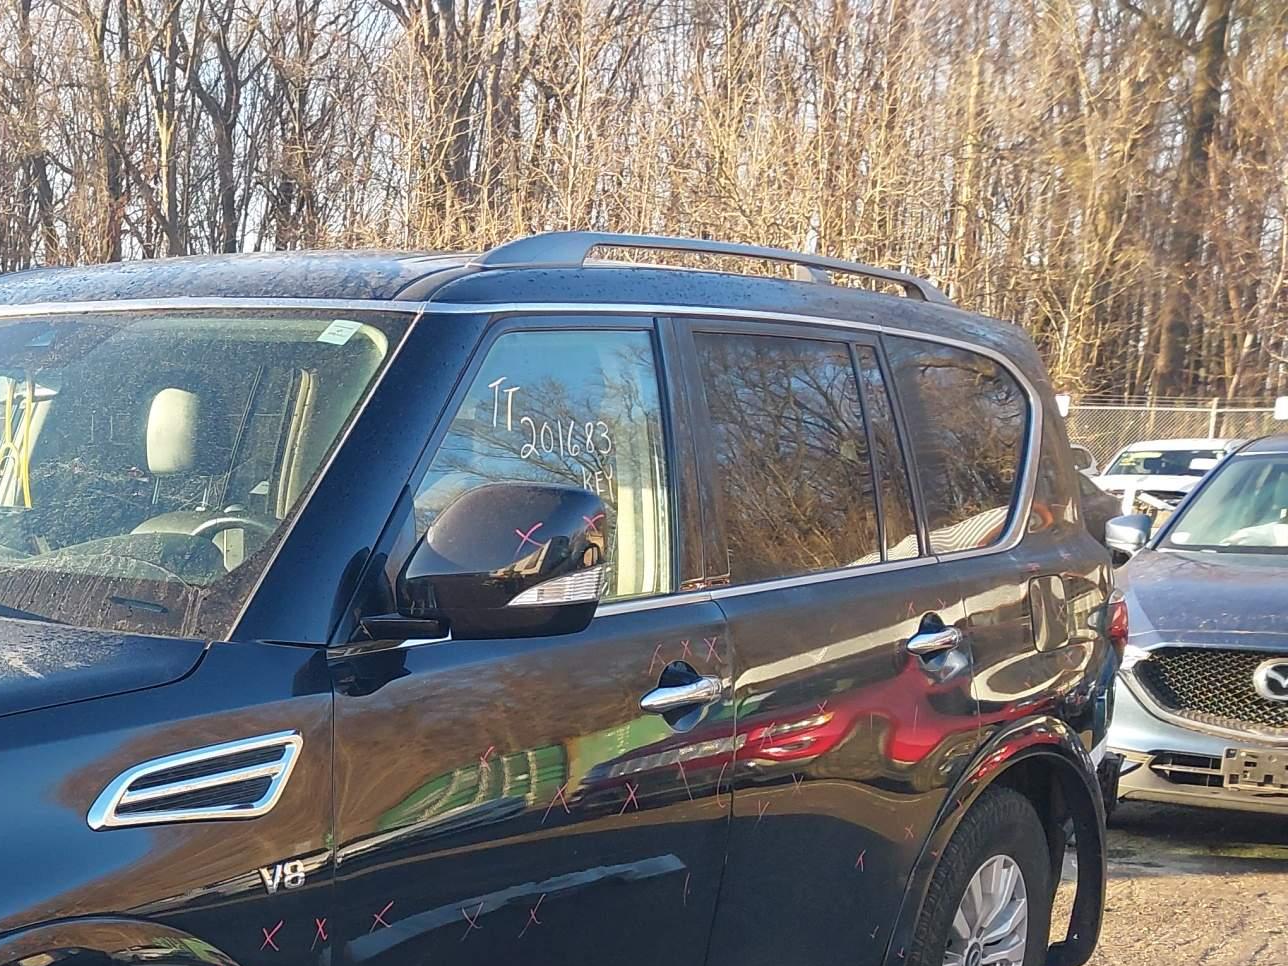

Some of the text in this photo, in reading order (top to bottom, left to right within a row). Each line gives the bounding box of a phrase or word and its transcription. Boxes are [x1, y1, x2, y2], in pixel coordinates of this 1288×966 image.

[520, 416, 612, 459] 201683
[581, 463, 615, 502] KEY
[258, 859, 306, 895] V8
